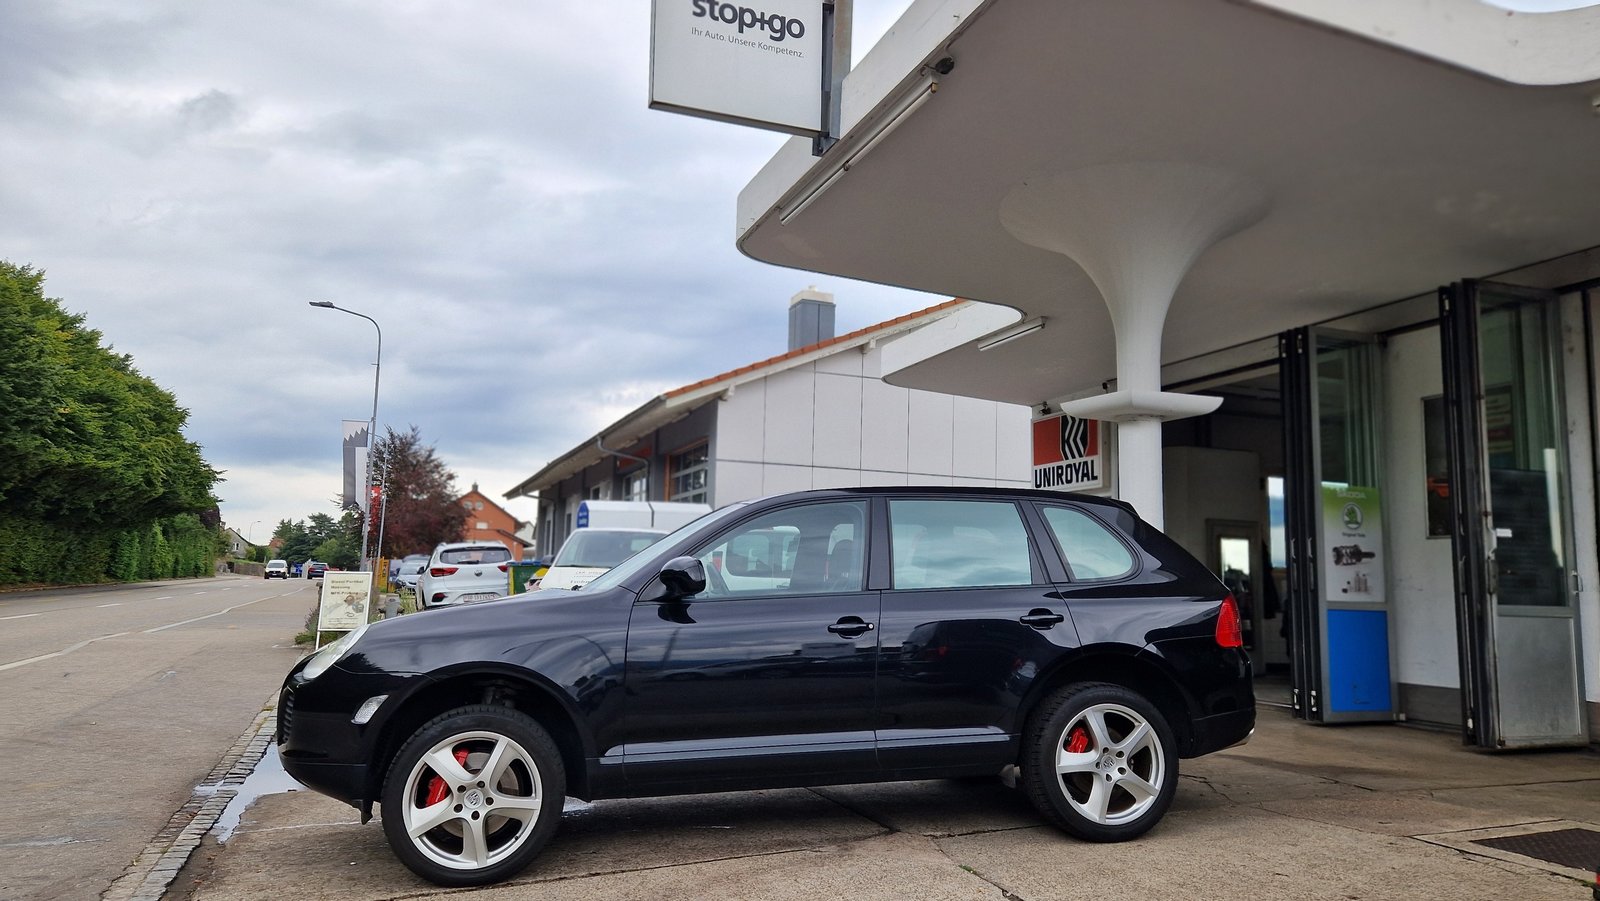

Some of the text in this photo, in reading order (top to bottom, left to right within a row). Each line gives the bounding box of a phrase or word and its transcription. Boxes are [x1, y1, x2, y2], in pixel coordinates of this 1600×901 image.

[692, 0, 805, 42] stop+go
[691, 27, 804, 58] Ihr Auto. Unsere Kompetenz.
[1035, 460, 1098, 488] UNIROYAL
